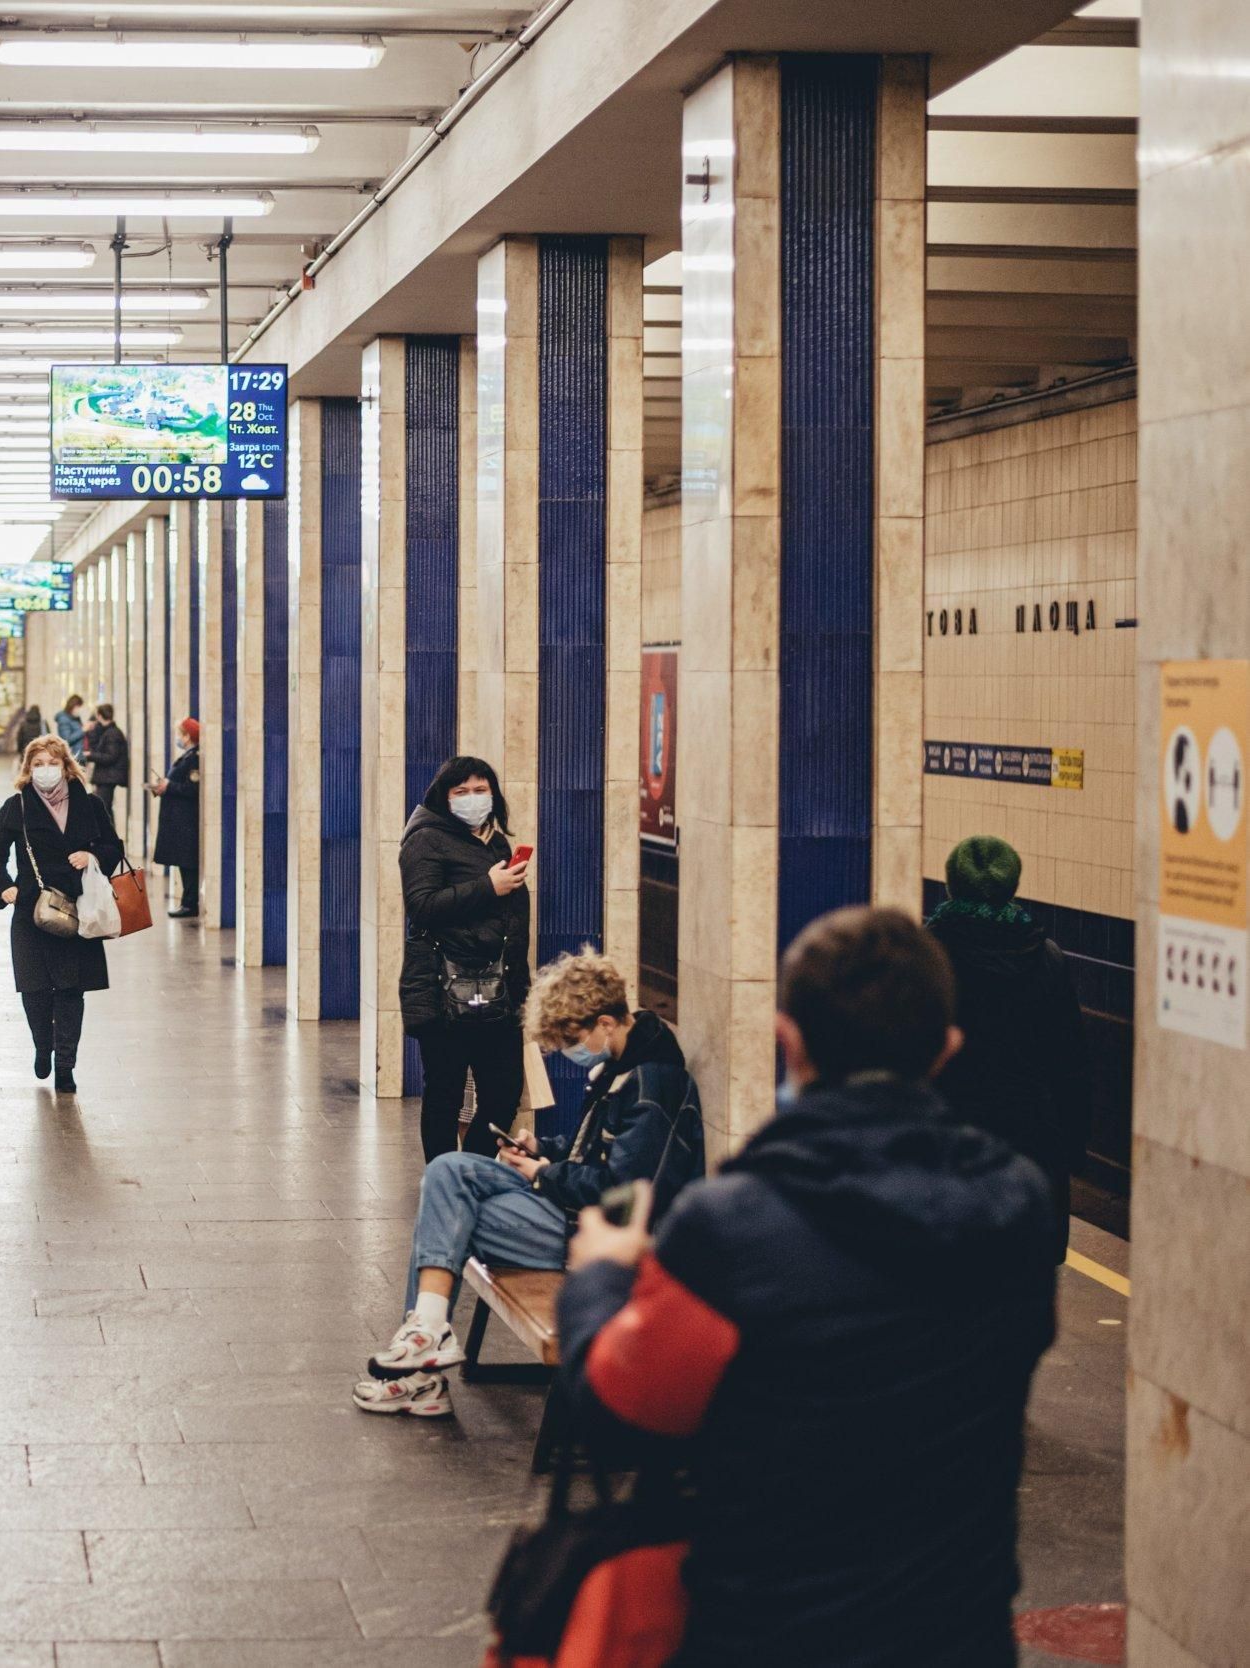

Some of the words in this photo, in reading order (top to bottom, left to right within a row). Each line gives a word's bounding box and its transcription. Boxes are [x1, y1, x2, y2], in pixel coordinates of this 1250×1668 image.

[229, 372, 284, 391] 17:29
[229, 401, 256, 422] 28
[257, 403, 275, 411] Thu.
[257, 413, 275, 421] Oct.
[229, 424, 245, 434] Чт.
[246, 423, 279, 434] Жовт.
[229, 442, 260, 453] Завтра
[261, 443, 282, 451] tom.
[237, 453, 274, 469] 12°C
[54, 464, 117, 478] Наступний
[54, 476, 86, 487] поїзд
[87, 477, 121, 488] через
[131, 465, 222, 494] 00:58
[54, 486, 73, 494] Next
[74, 486, 92, 494] train
[1015, 599, 1096, 636] ПЛОЩА
